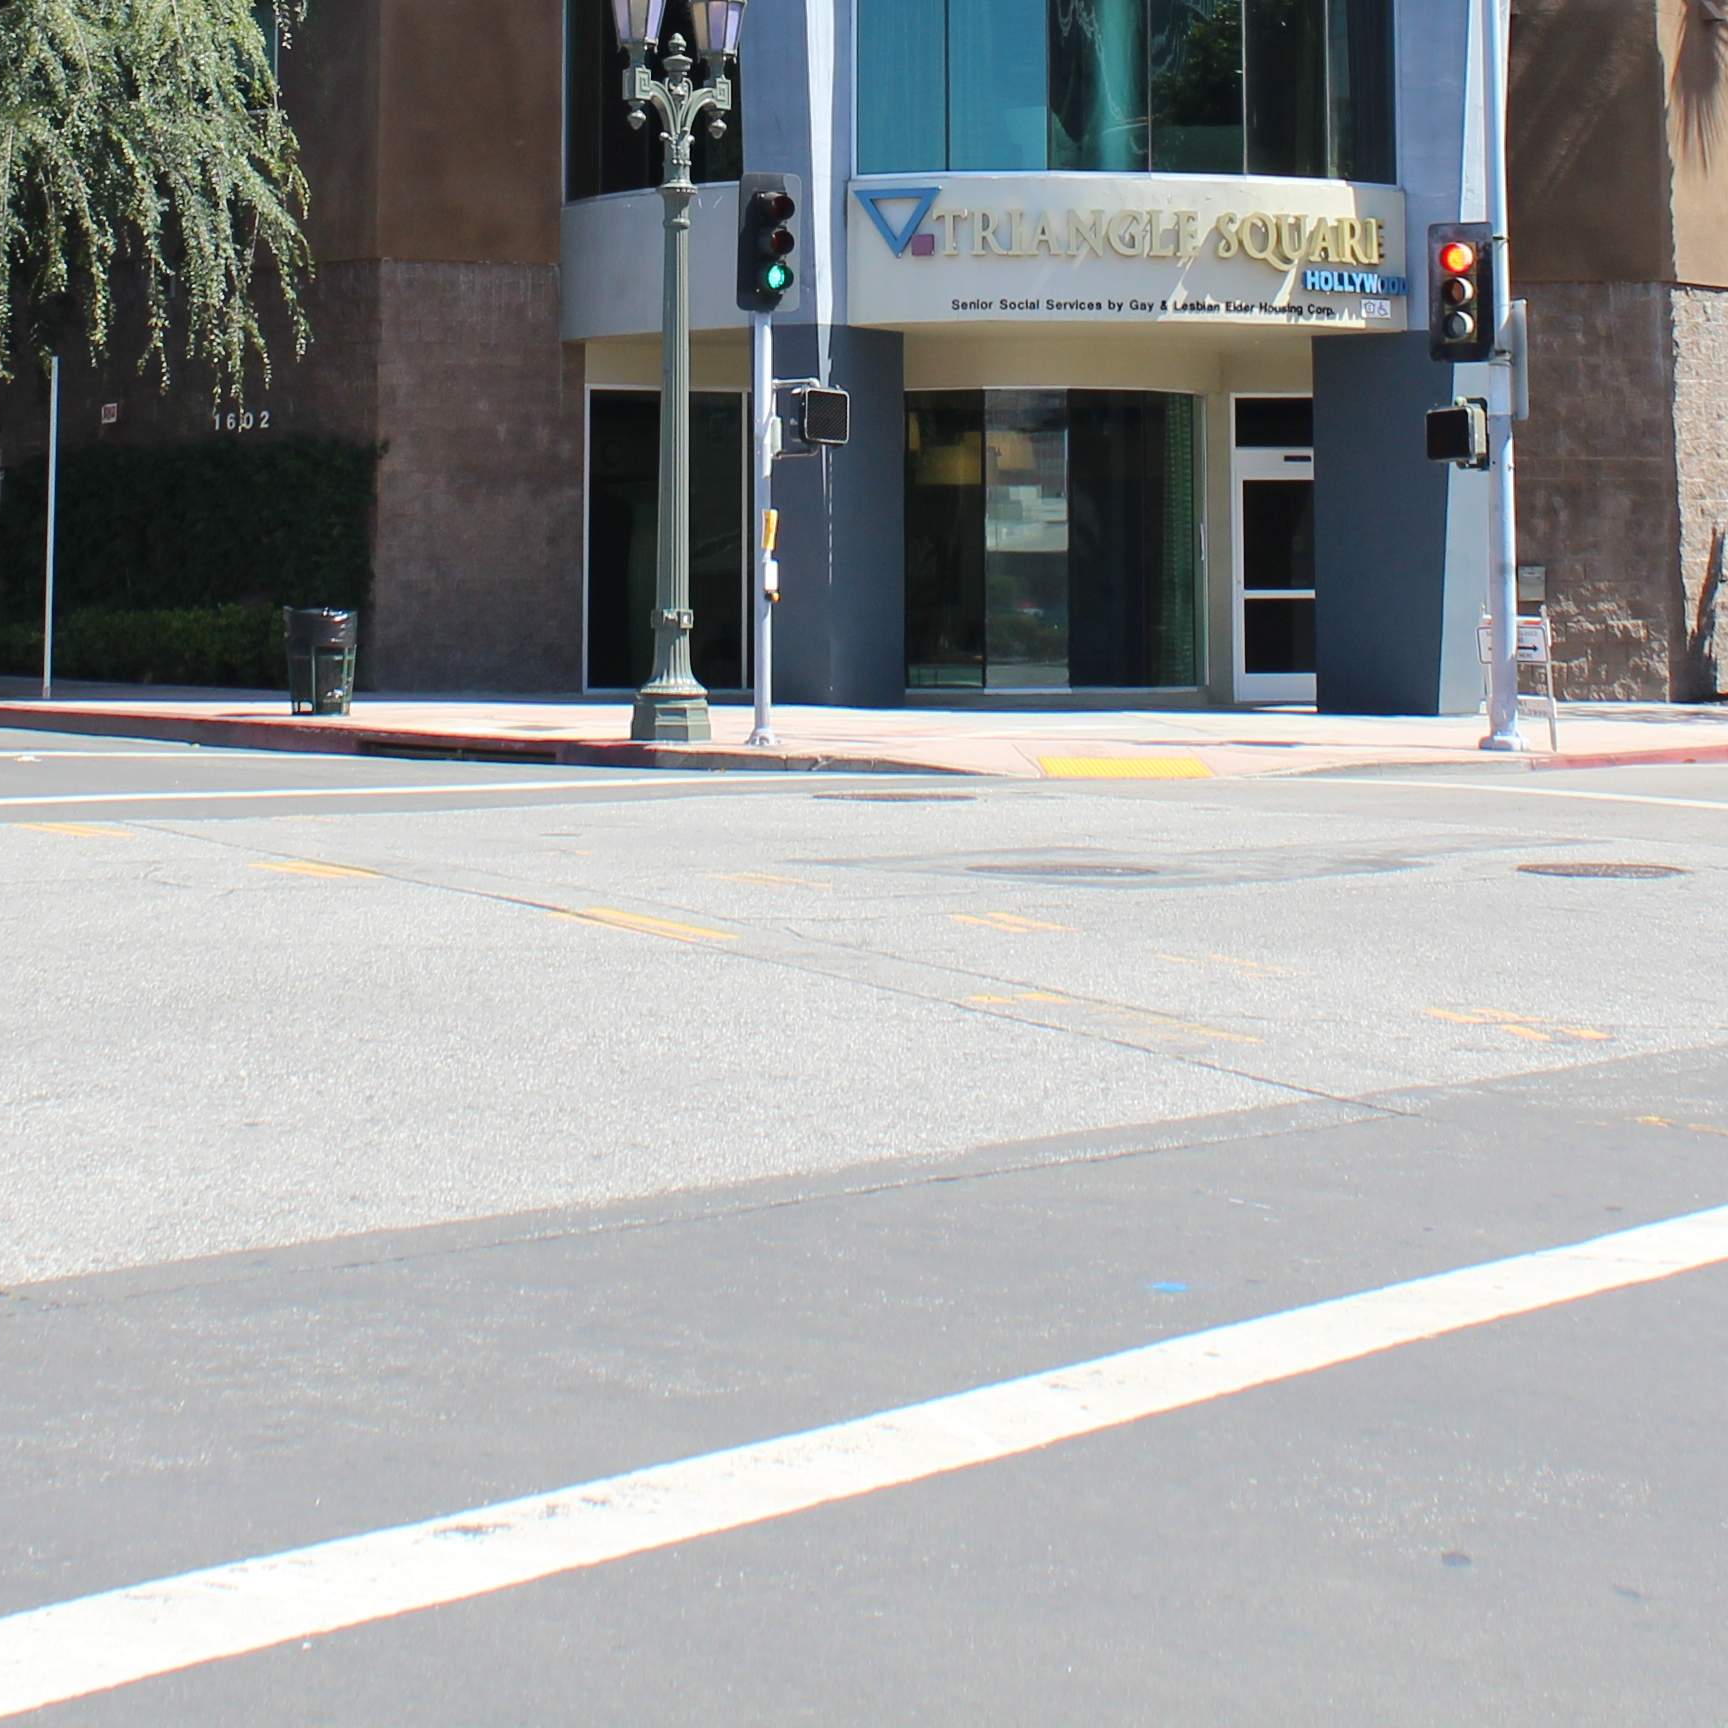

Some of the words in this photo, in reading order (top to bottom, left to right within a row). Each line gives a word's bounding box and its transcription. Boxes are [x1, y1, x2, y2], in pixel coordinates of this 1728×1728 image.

[932, 208, 1200, 258] TRIANGLE
[1215, 211, 1385, 271] SQUARE
[951, 298, 993, 311] Senior
[999, 298, 1040, 311] Social
[1045, 298, 1102, 311] Services
[1108, 299, 1124, 312] by
[1129, 299, 1154, 313] Gay
[1160, 300, 1168, 311] &
[1173, 300, 1220, 313] Lesbian
[1225, 301, 1255, 314] Elder
[1259, 301, 1303, 317] Housing
[1307, 303, 1335, 317] Corp.
[213, 410, 270, 431] 1602
